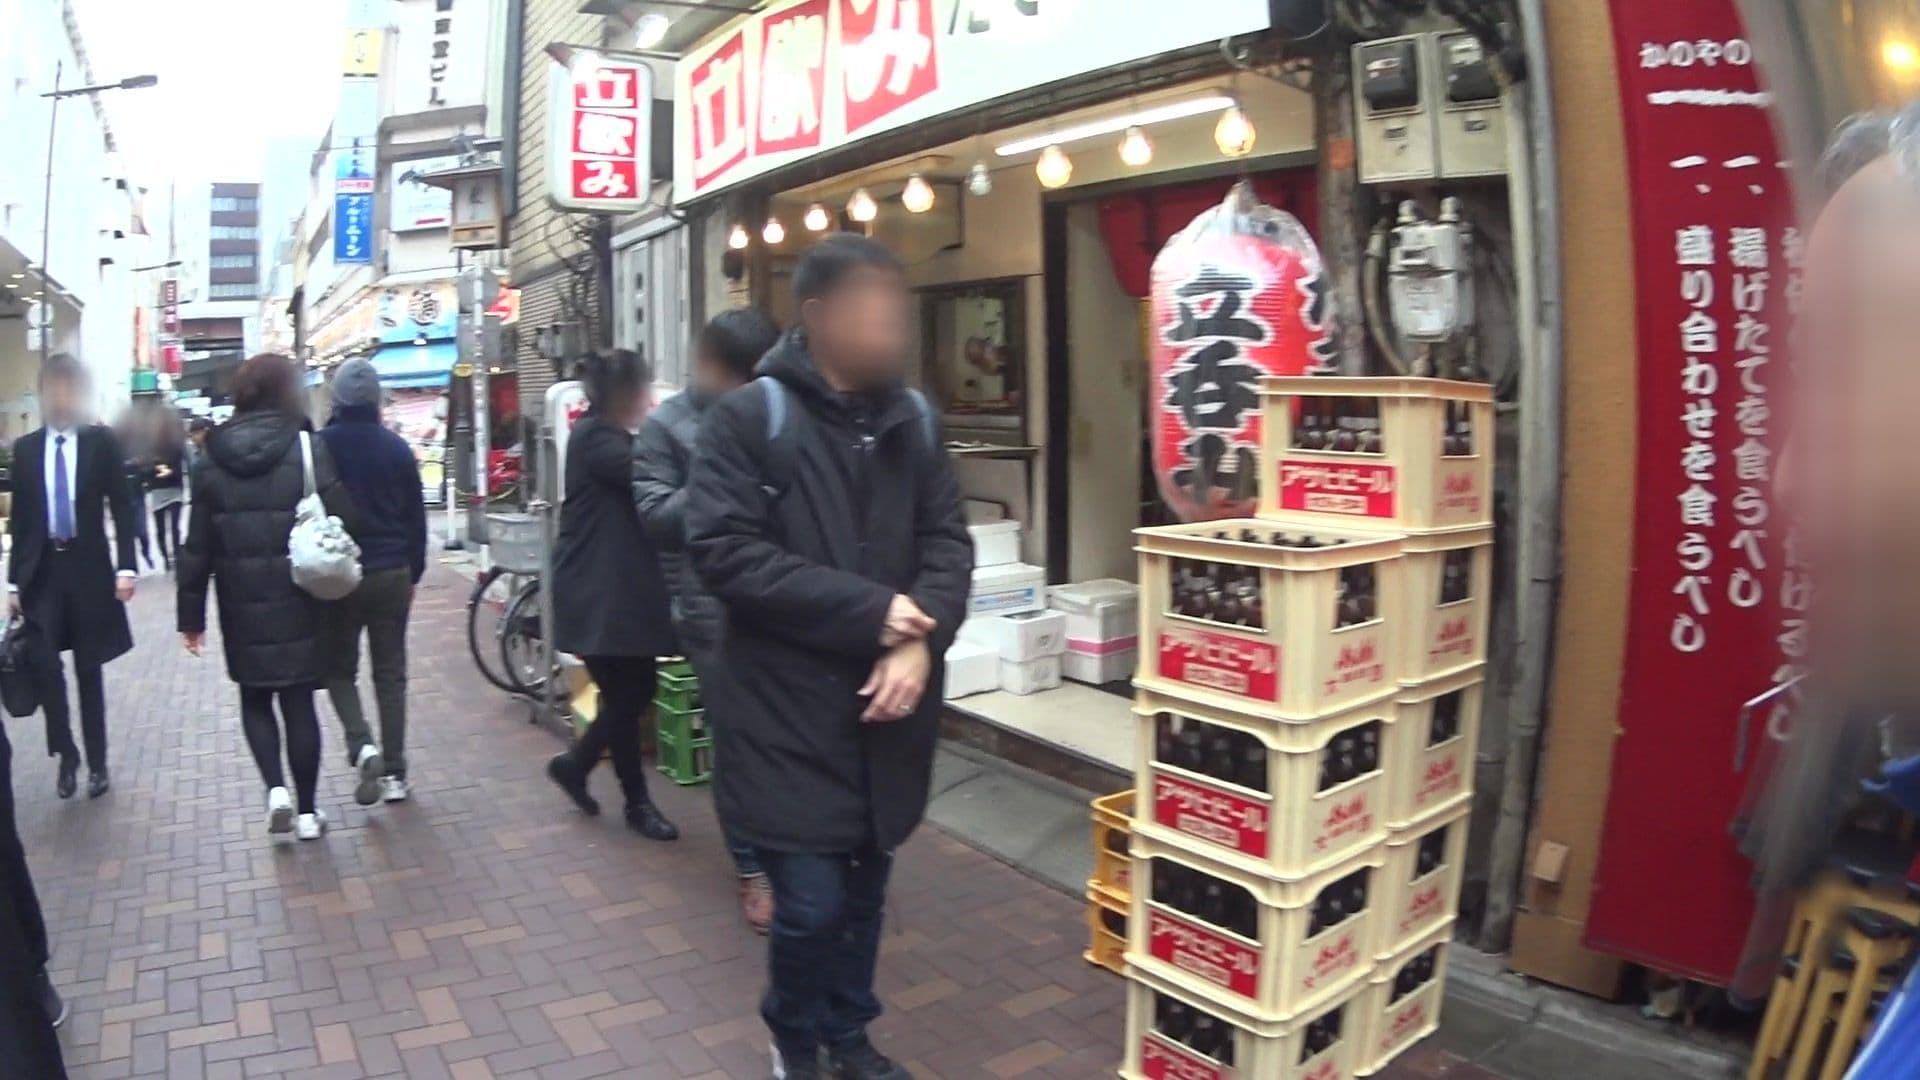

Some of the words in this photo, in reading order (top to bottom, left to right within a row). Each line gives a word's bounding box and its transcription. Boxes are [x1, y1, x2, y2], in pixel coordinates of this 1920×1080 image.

[692, 0, 932, 176] 立飲み
[1638, 38, 1751, 69] かのやの
[578, 70, 636, 197] 立飲み
